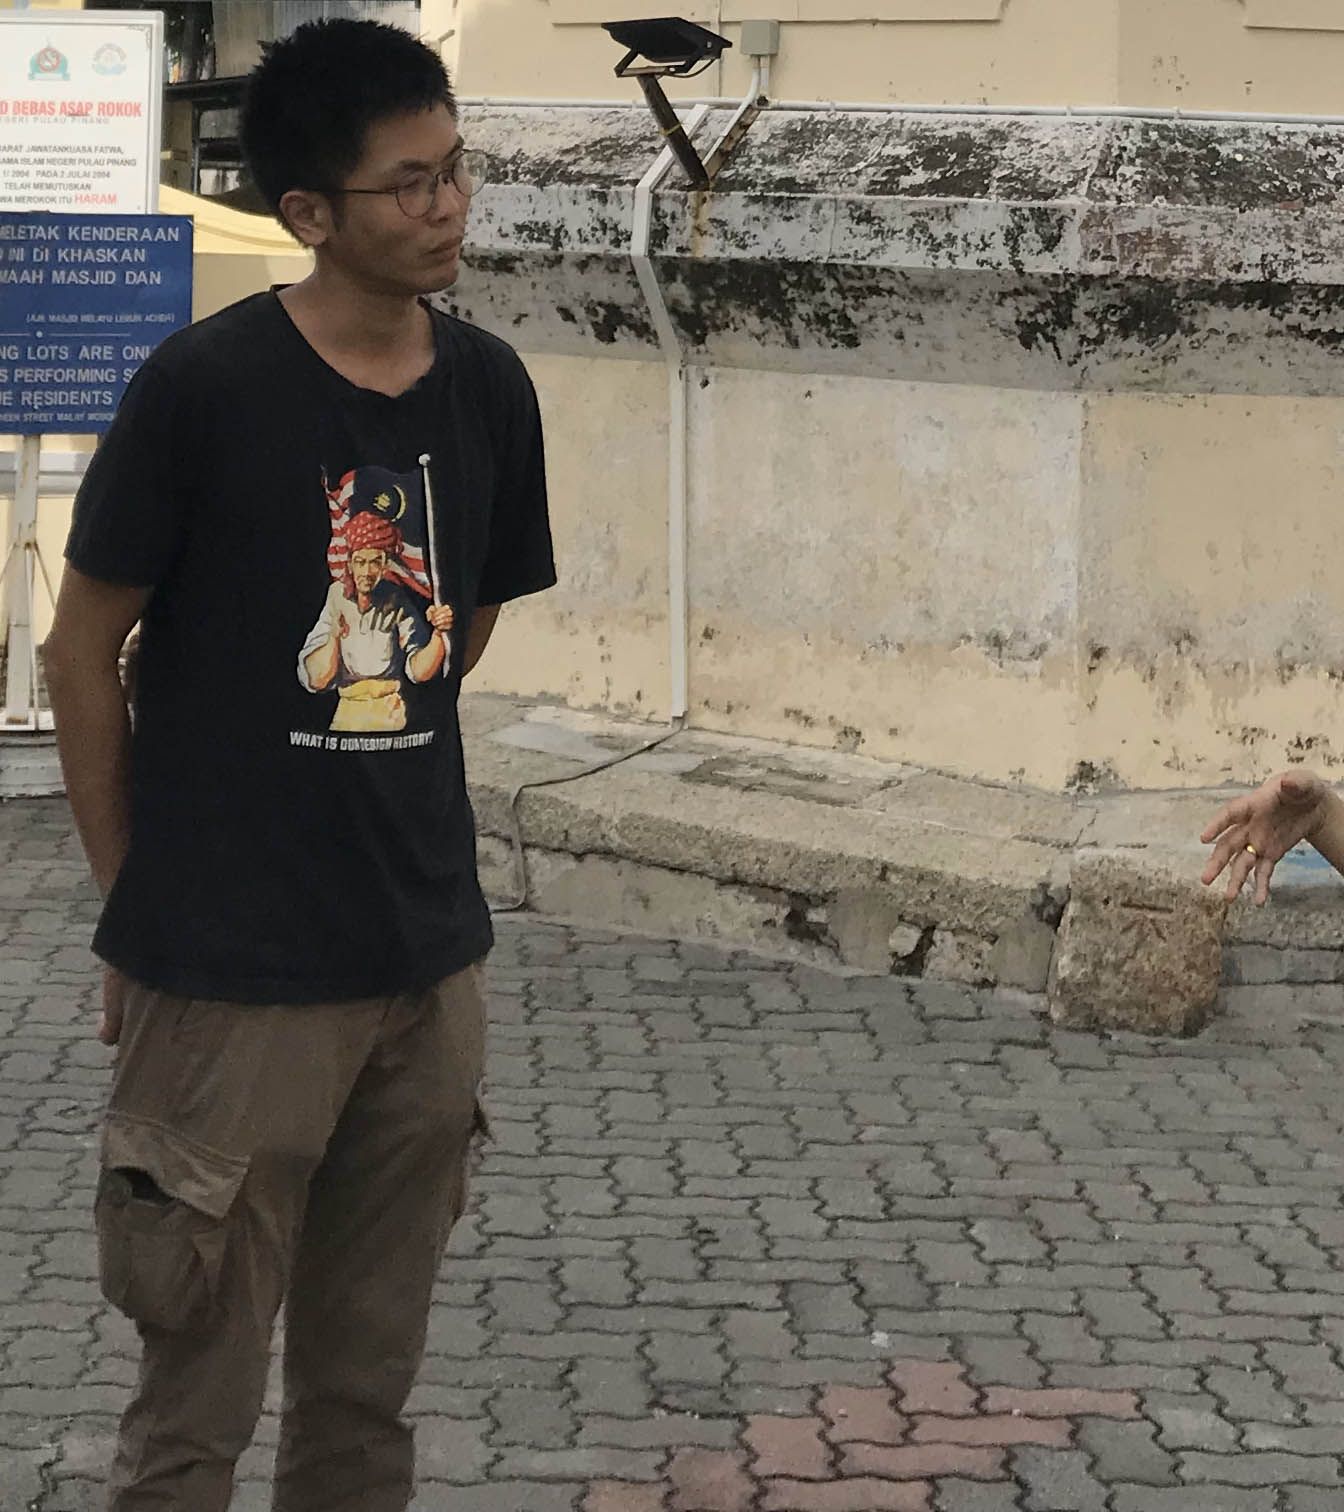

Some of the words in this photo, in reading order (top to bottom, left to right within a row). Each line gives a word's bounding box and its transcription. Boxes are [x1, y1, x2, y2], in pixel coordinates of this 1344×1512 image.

[12, 100, 56, 117] BEBAS
[59, 101, 94, 117] ASAP
[97, 101, 142, 118] ROKOK
[33, 116, 67, 125] PULAU
[71, 116, 110, 125] PINANG
[25, 145, 92, 154] JAWATANKUASA
[20, 157, 45, 166] ISLAM
[46, 158, 76, 167] NEGERI
[78, 158, 105, 167] PULAU
[106, 158, 137, 167] PINANG
[36, 170, 58, 179] PADA
[67, 170, 90, 179] JULAI
[4, 182, 31, 190] TELAH
[33, 183, 92, 191] MEMUTUSKAN
[14, 195, 57, 205] MEROKOK
[59, 195, 72, 204] ITU
[74, 194, 117, 205] HARAM
[68, 226, 180, 242] KENDERAAN
[7, 247, 25, 262] INI
[32, 247, 50, 263] DI
[57, 248, 147, 263] KHASKAN
[51, 270, 117, 285] MASJID
[124, 271, 162, 285] DAN
[27, 345, 70, 361] LOTS
[78, 345, 114, 361] ARE
[122, 345, 156, 361] ONL
[14, 368, 117, 384] PERFORMING
[20, 390, 114, 407] RESIDENTS
[22, 413, 55, 423] STREET
[56, 413, 85, 424] MALAY
[289, 731, 324, 749] WHAT
[324, 736, 338, 751] IS
[393, 730, 435, 749] HISTORY?
